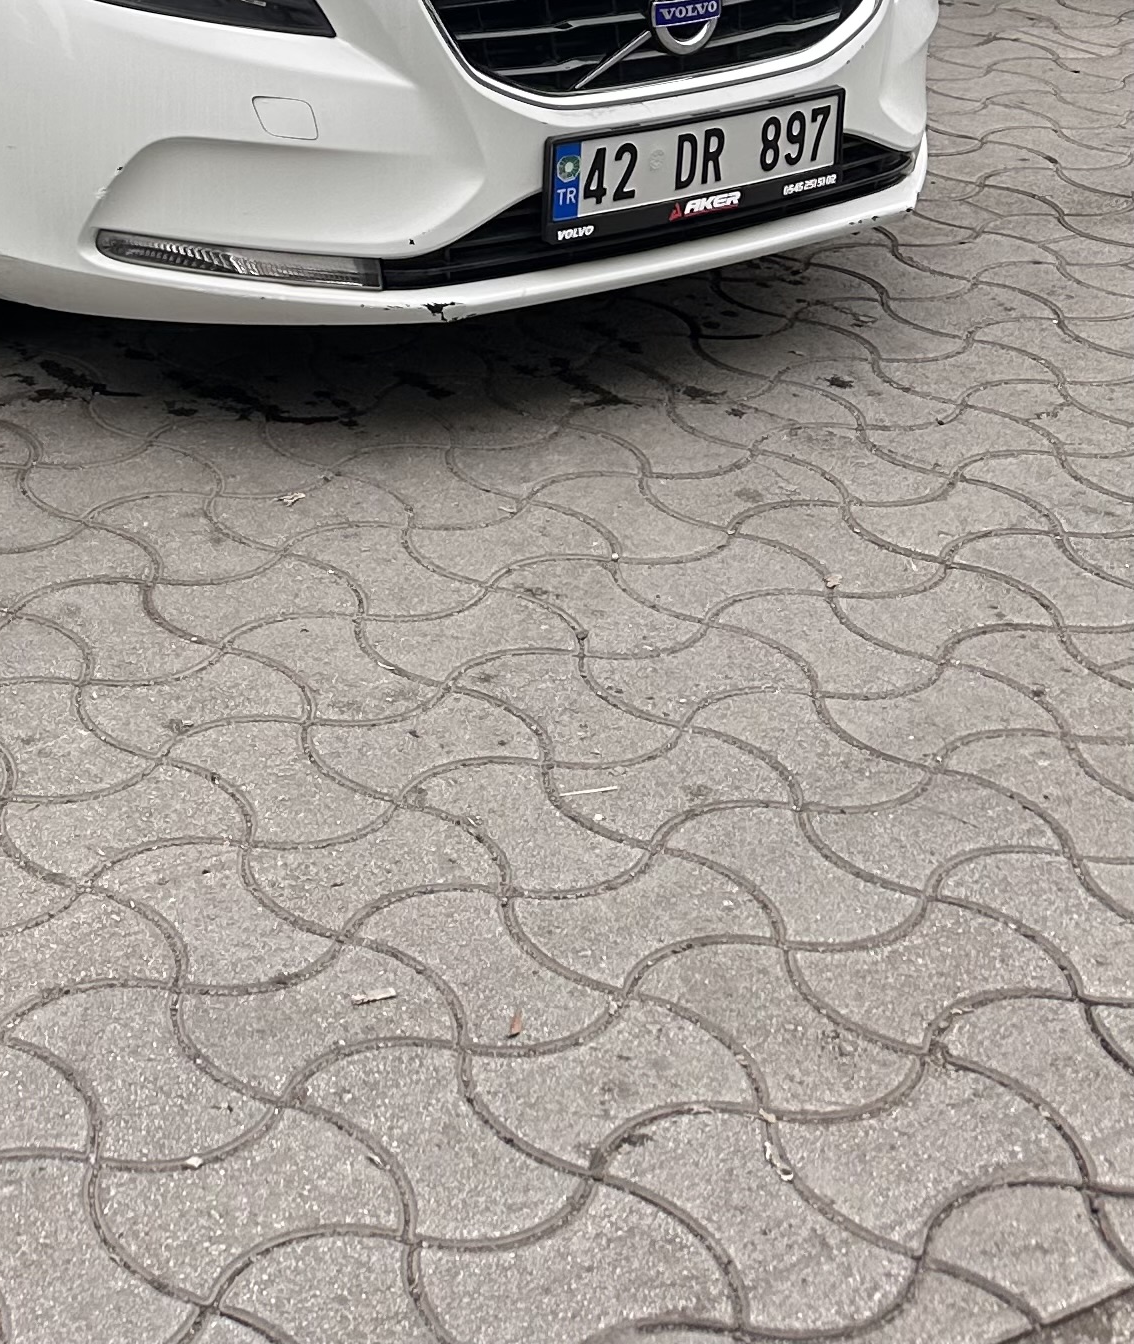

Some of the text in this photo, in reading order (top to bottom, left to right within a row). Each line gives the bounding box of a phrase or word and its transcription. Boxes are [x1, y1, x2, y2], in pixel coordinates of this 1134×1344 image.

[659, 0, 718, 21] VOLVO
[583, 104, 833, 205] 42 DR 897
[556, 186, 577, 206] TR
[557, 225, 595, 241] VOLVO
[683, 190, 742, 215] AKER
